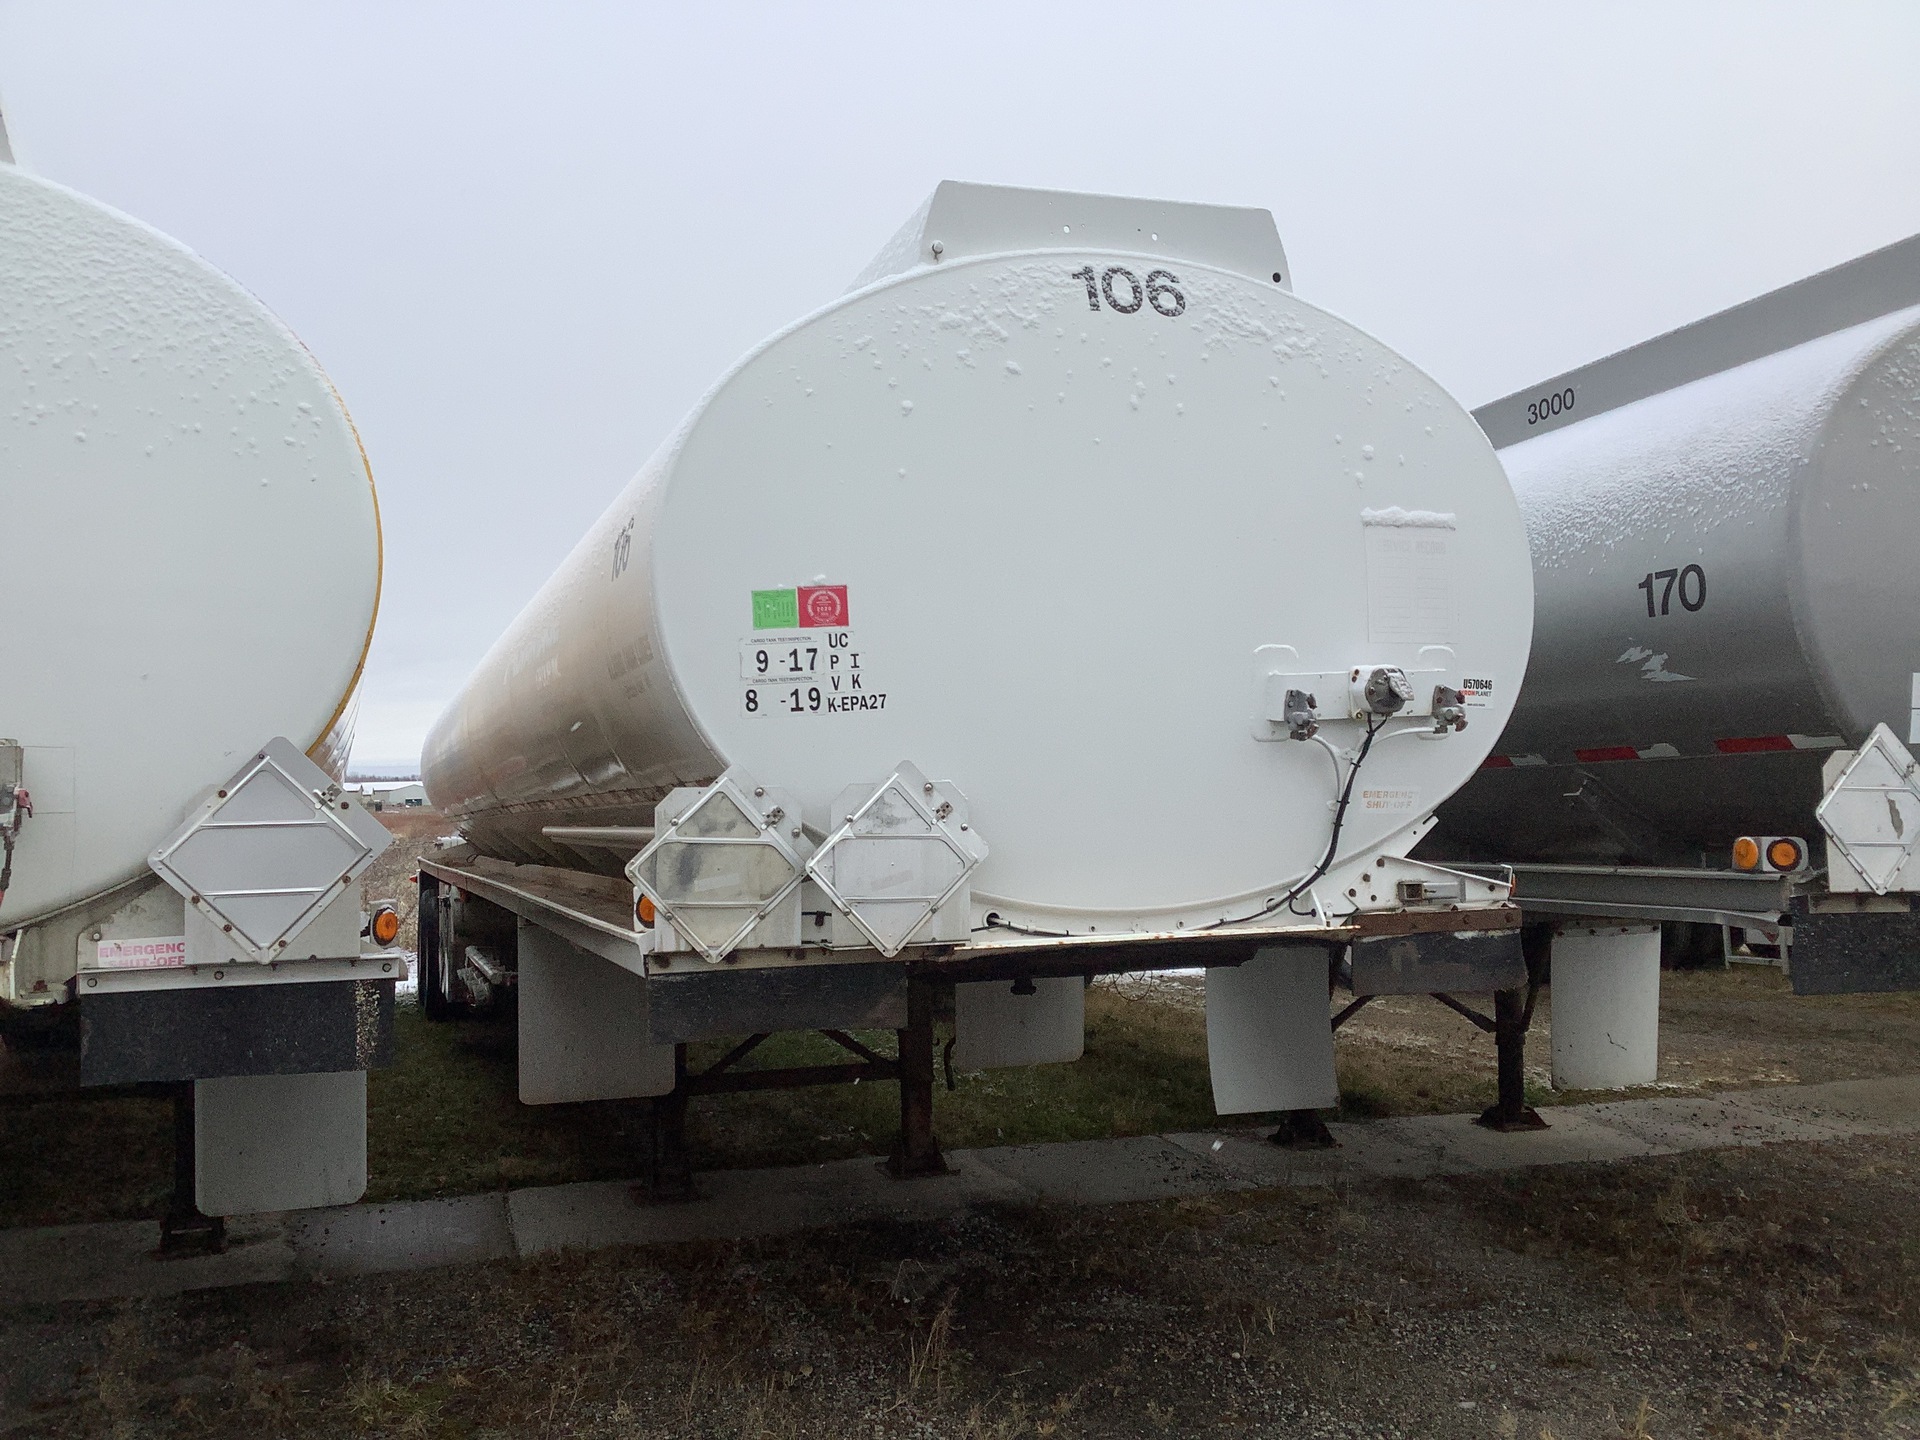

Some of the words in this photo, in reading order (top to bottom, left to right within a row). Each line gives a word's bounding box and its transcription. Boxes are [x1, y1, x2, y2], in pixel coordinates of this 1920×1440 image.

[1071, 266, 1186, 317] 106
[1527, 387, 1575, 425] 3000
[1638, 563, 1706, 618] 170
[828, 632, 849, 648] UC
[756, 649, 769, 673] 9
[830, 654, 840, 670] P
[850, 653, 860, 669] I
[831, 675, 841, 691] V
[851, 673, 862, 689] K
[1463, 679, 1493, 690] U570646
[745, 689, 759, 713] 8
[828, 693, 887, 713] K-EPA27
[1362, 790, 1416, 799] EMERGENC
